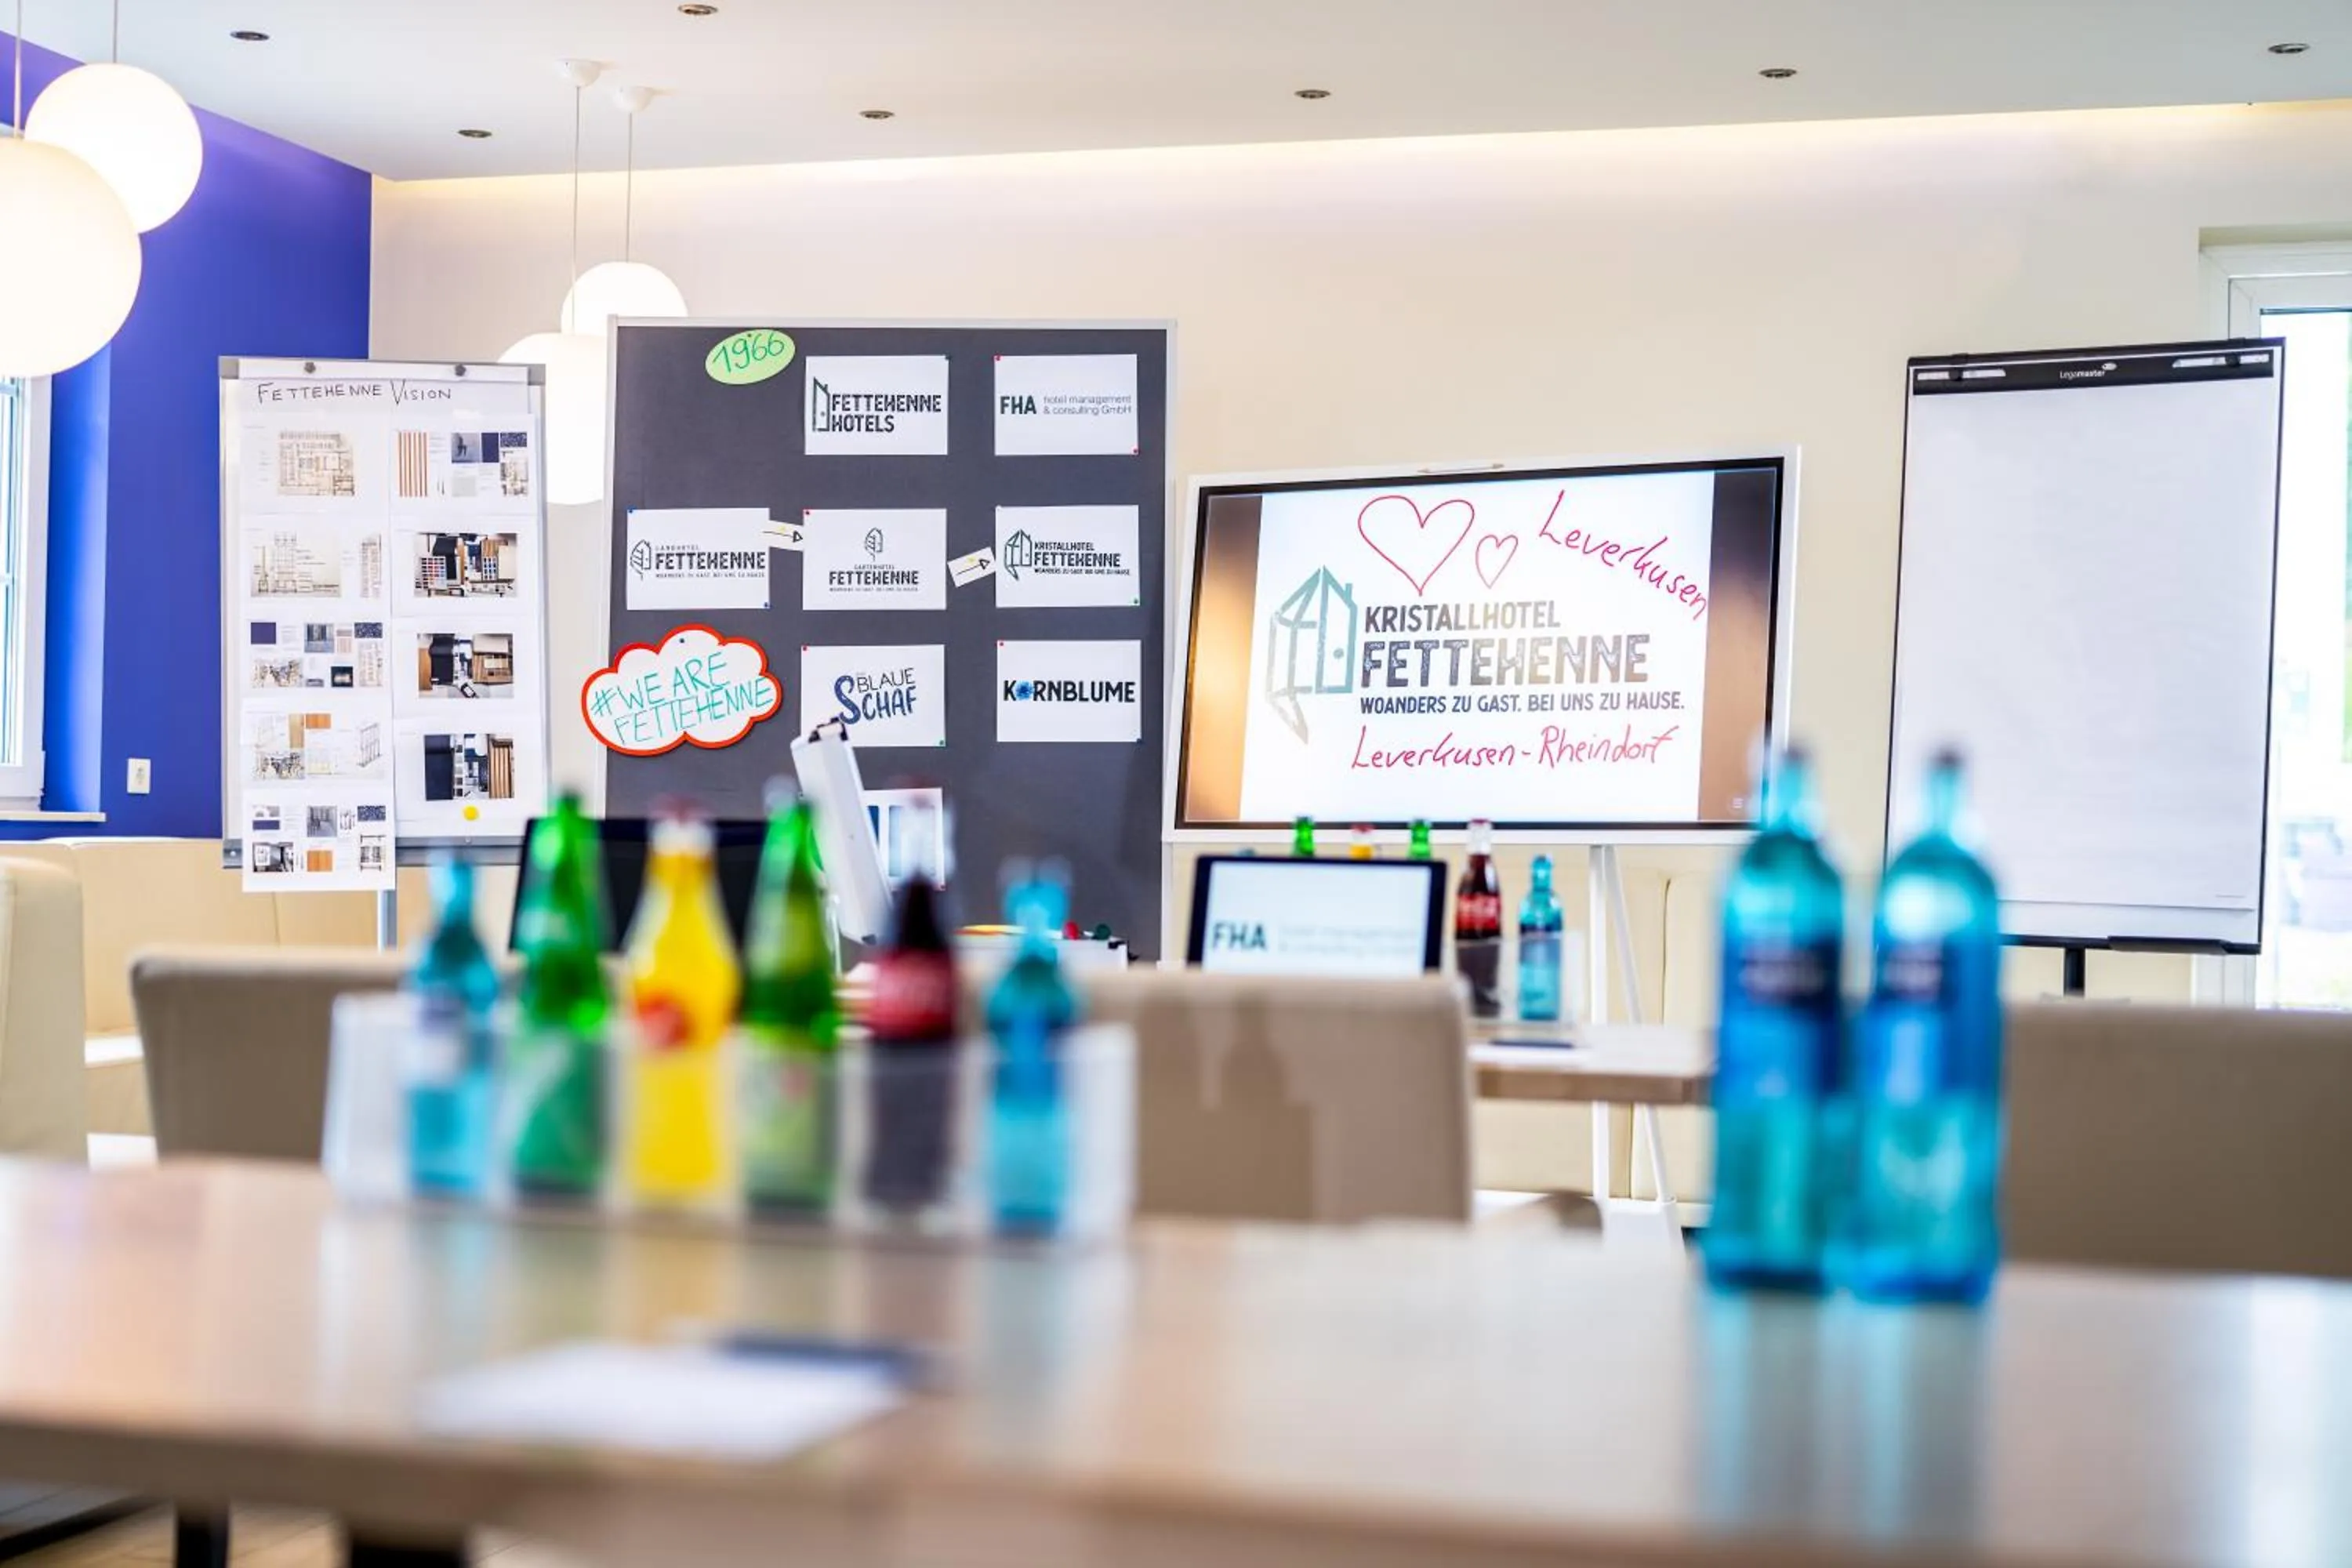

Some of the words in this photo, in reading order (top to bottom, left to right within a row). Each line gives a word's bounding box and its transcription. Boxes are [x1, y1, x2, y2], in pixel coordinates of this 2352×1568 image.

[712, 332, 785, 373] 1966
[832, 394, 942, 412] FETTEHENNE
[1000, 395, 1036, 414] FHA
[1043, 395, 1067, 405] hotel
[1069, 395, 1131, 405] management
[1052, 406, 1099, 416] consulting
[1101, 405, 1131, 415] GmbH
[832, 414, 895, 433] HOTELS
[655, 551, 766, 570] FETTEHENNE
[1034, 552, 1121, 567] FETTEHENNE
[1538, 488, 1708, 621] Leverkusen
[829, 570, 919, 585] FETTEHENNE
[1365, 601, 1561, 633] KRISTALLHOTEL
[1360, 634, 1650, 688] FETTEHENNE
[590, 673, 665, 717] #WE
[673, 652, 731, 698] ARE
[856, 667, 916, 693] BLAUE
[614, 677, 775, 745] FETTEHENNE
[834, 675, 916, 724] SCHAF
[1360, 696, 1447, 714] WOANDERS
[1451, 696, 1472, 712] ZU
[1477, 695, 1522, 712] GAST.
[1527, 694, 1555, 711] BEI
[1559, 693, 1594, 710] UNS
[1599, 693, 1621, 710] ZU
[1626, 691, 1685, 710] HAUSE.
[1212, 921, 1267, 951] FHA
